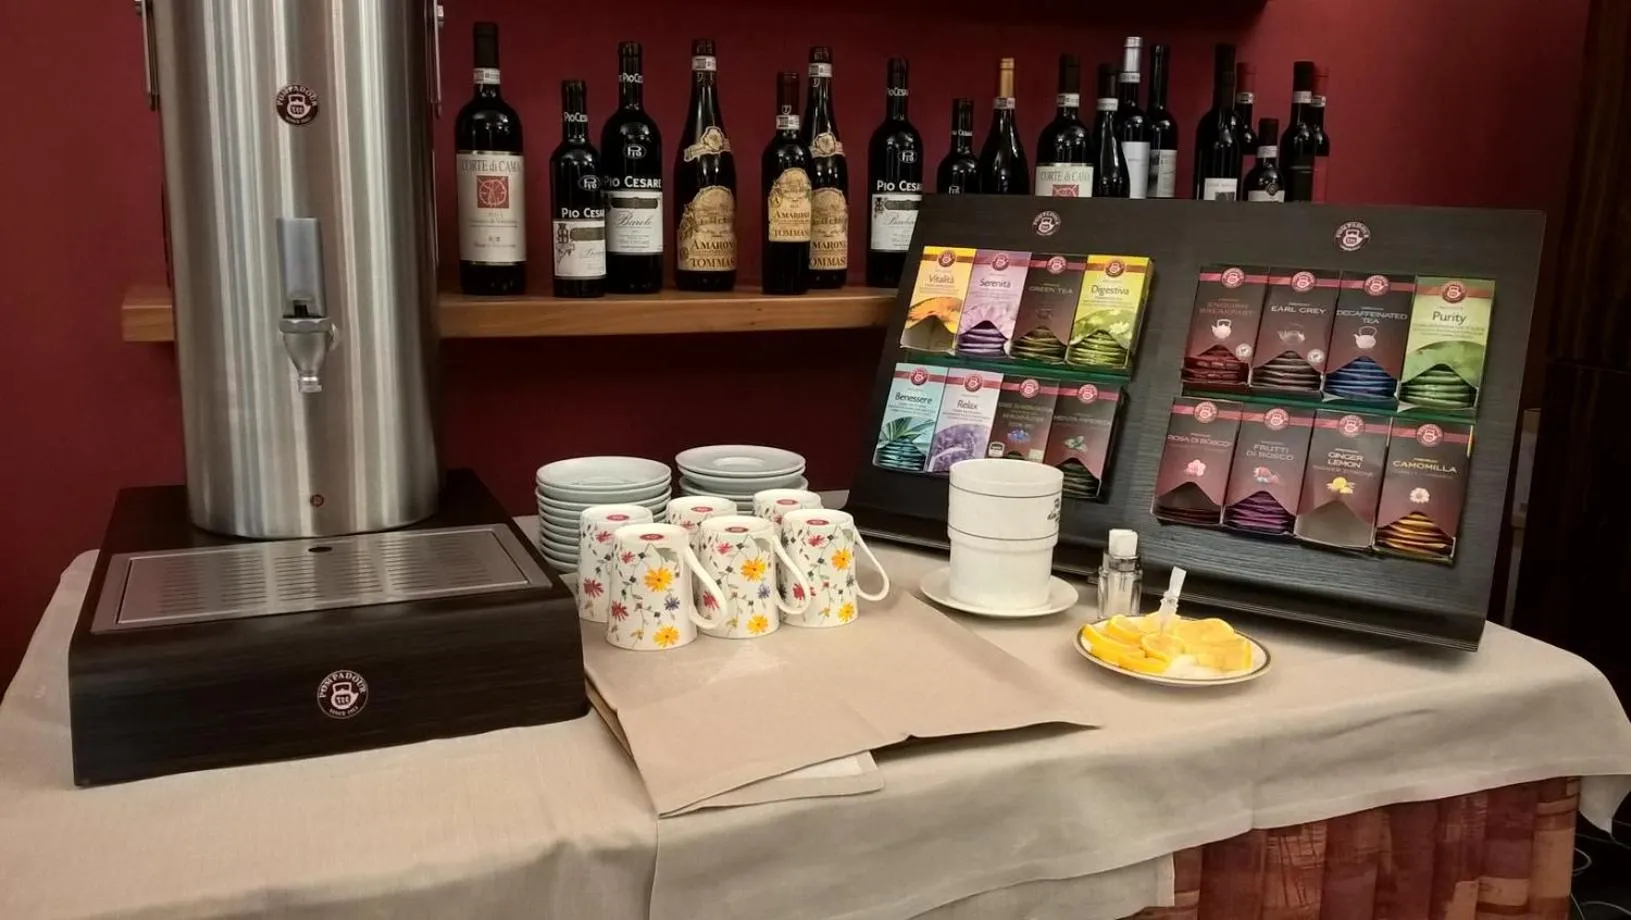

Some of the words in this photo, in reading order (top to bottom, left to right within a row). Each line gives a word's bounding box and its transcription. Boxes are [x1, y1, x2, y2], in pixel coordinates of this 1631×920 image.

[877, 179, 895, 191] PIO
[561, 207, 580, 218] PIO
[1090, 284, 1130, 297] Digestiva
[1271, 305, 1297, 314] EARL
[1298, 306, 1327, 315] GREY
[1432, 310, 1468, 326] Purity
[895, 391, 933, 405] Benessere
[957, 399, 979, 411] Relax
[1253, 443, 1290, 454] FRUTTI
[1246, 450, 1257, 459] DI
[1258, 451, 1294, 462] BOSCO
[1327, 450, 1364, 462] GINGER
[1327, 459, 1361, 469] LEMON
[1391, 459, 1458, 474] CAMOMILLA
[319, 672, 367, 698] POMPADOUR
